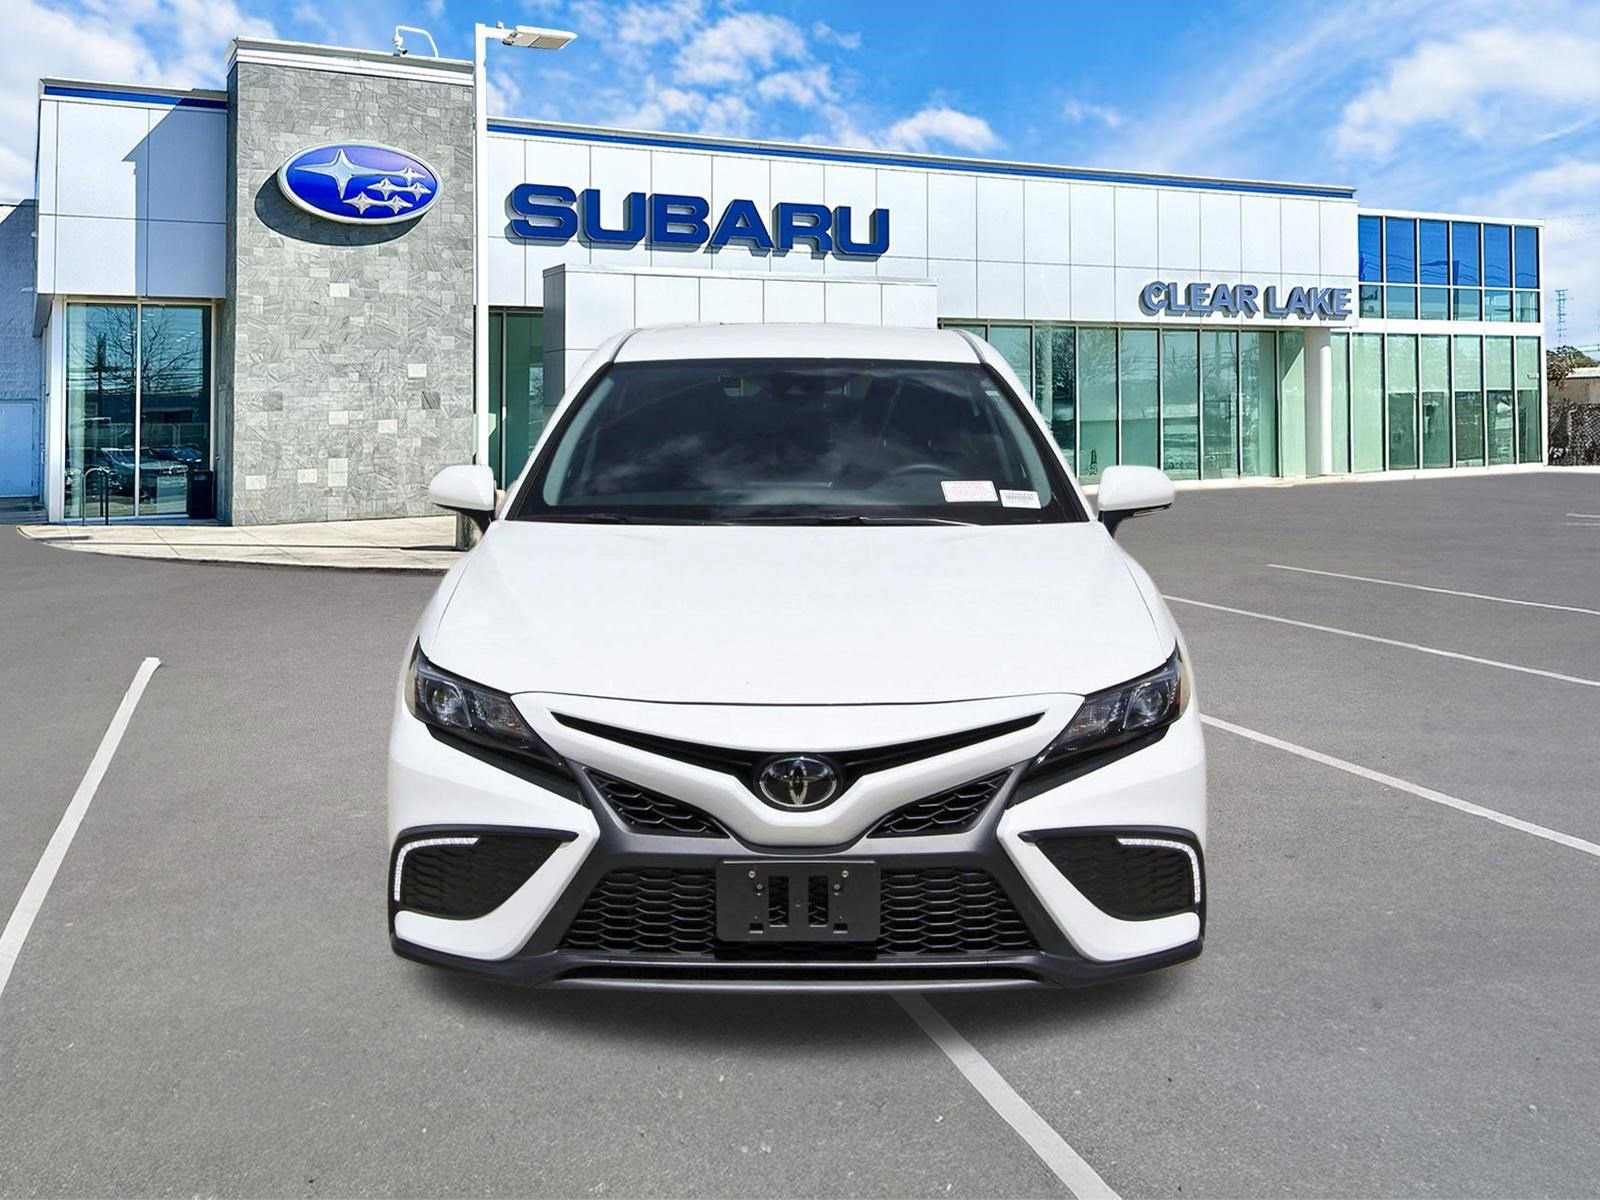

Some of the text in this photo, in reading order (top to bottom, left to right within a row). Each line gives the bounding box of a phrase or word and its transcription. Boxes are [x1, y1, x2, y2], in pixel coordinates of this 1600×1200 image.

[506, 183, 889, 259] SUBARU
[1140, 281, 1352, 319] CLEAR LAKE
